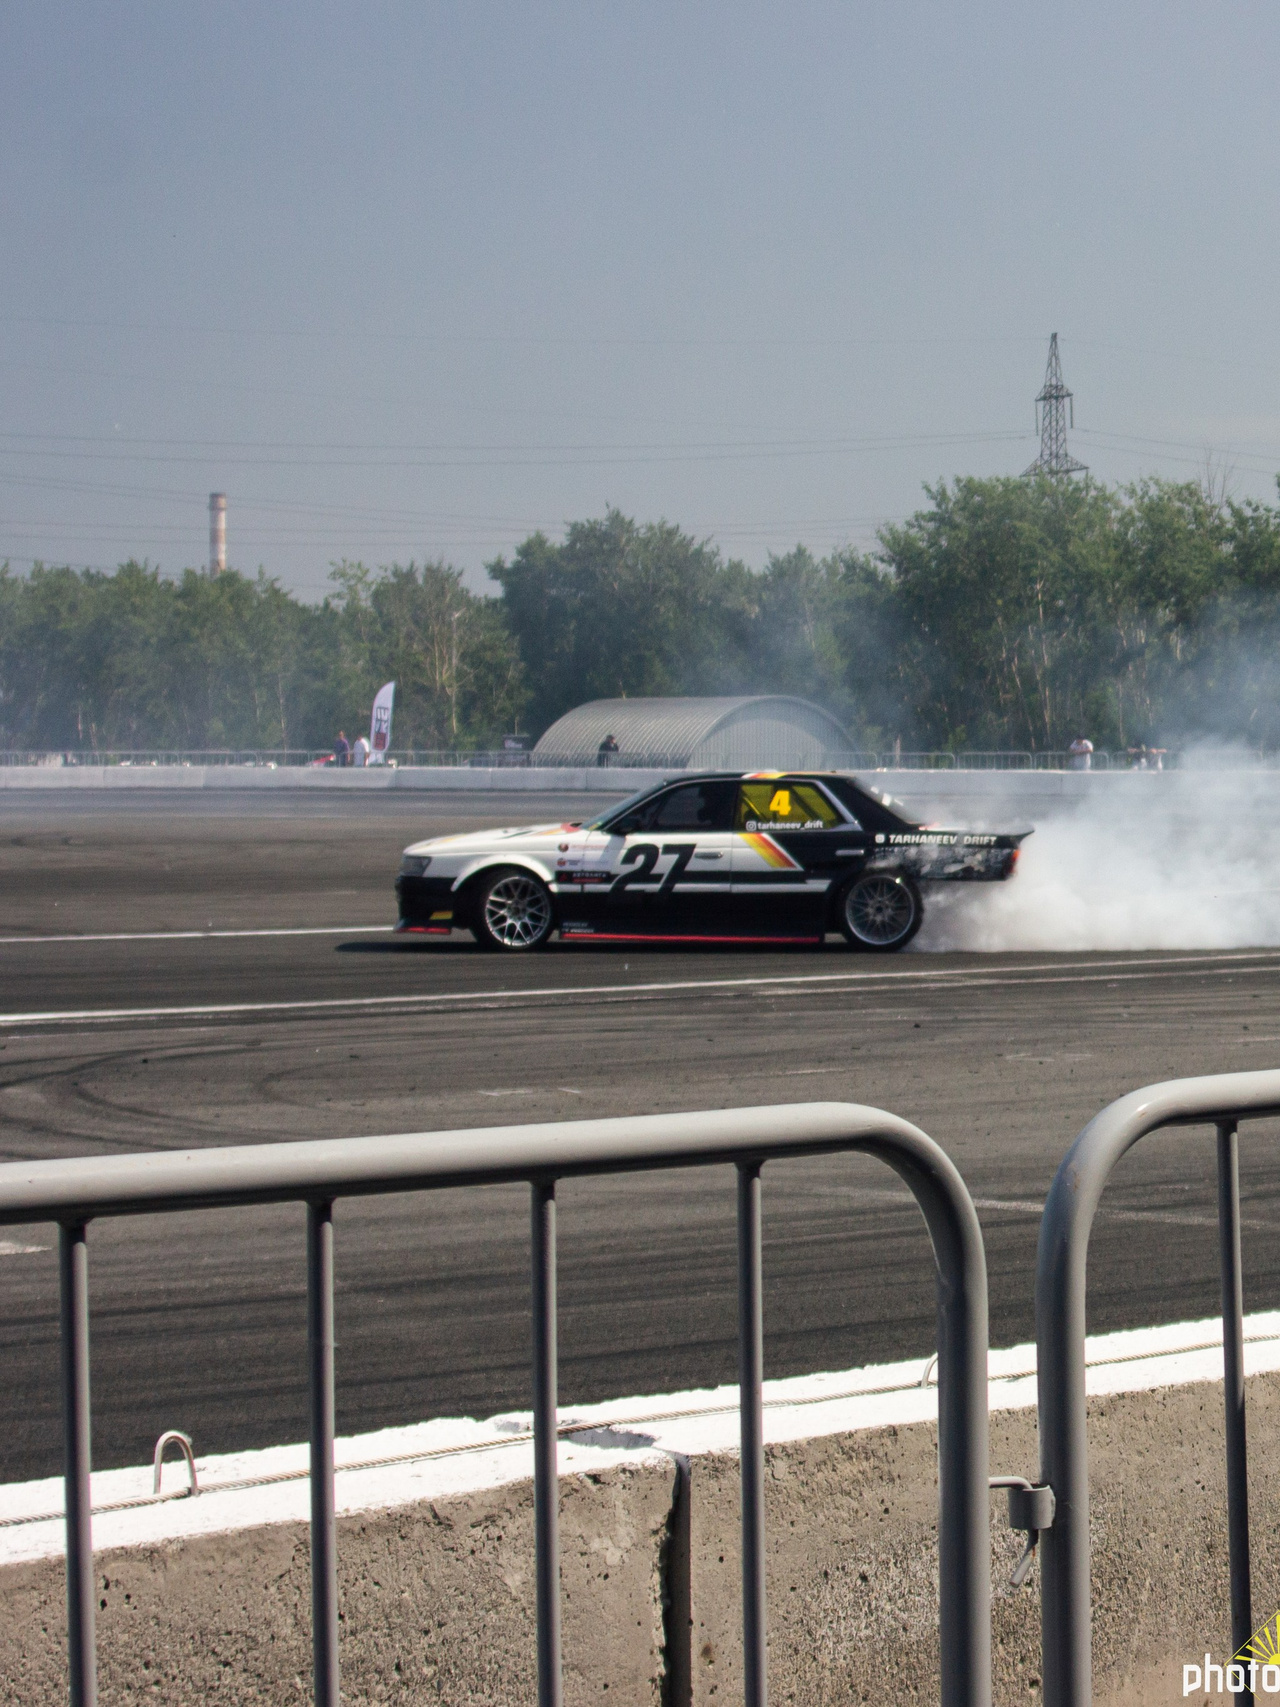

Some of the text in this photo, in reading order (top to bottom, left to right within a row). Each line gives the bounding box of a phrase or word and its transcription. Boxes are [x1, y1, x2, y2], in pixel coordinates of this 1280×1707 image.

[769, 789, 792, 816] 4
[757, 820, 824, 831] tarhaneev_drift
[888, 834, 998, 846] TARHANEEV DRIFT
[608, 842, 697, 895] 27
